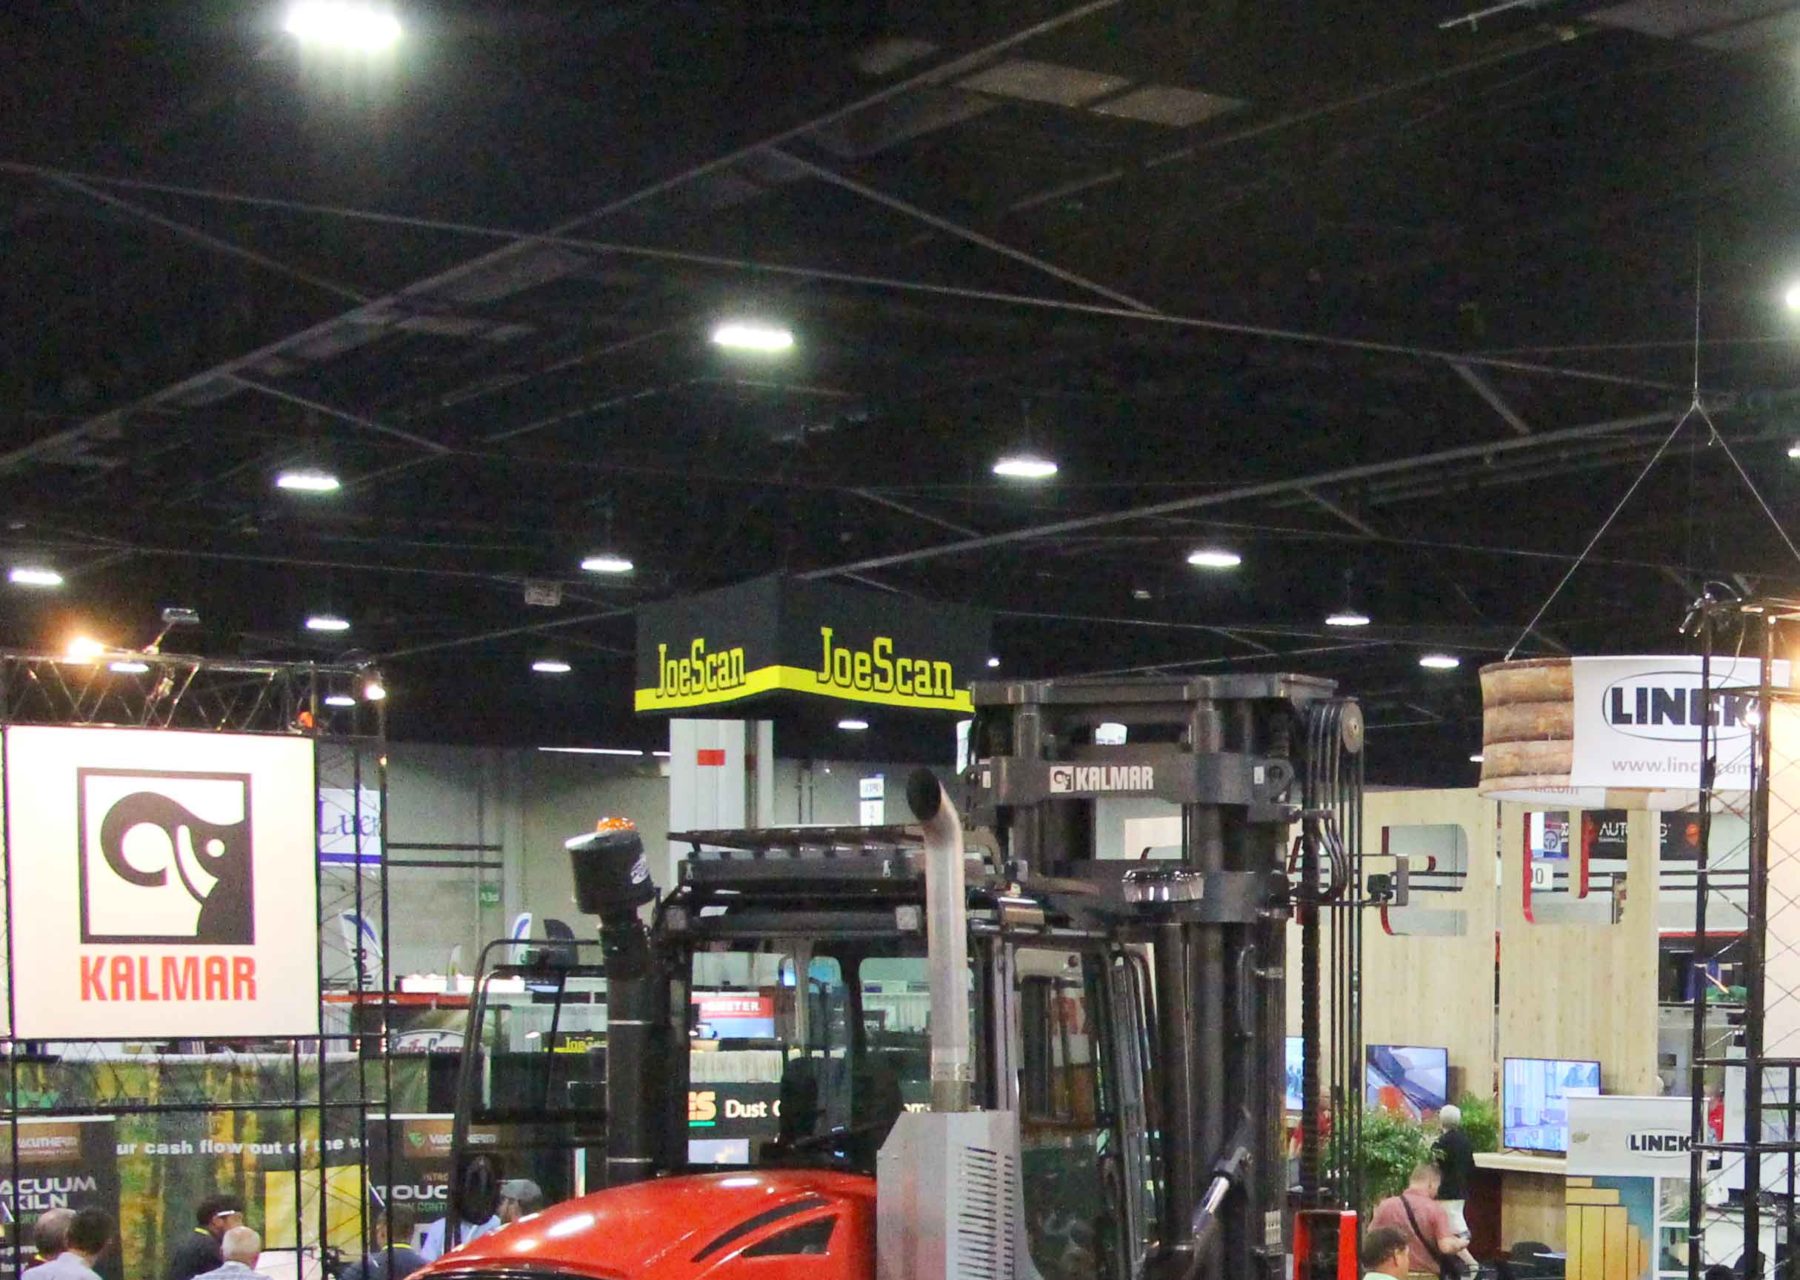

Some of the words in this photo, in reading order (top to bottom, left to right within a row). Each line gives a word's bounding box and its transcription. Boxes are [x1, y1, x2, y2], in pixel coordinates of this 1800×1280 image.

[655, 637, 746, 697] JoeScan
[816, 626, 955, 698] JoeScan
[1076, 766, 1154, 791] KALMAR
[79, 955, 257, 1001] KALMAR
[725, 1099, 766, 1118] Dust
[144, 1140, 194, 1155] cash
[200, 1139, 243, 1154] flow
[250, 1141, 283, 1155] out
[1630, 1134, 1693, 1152] LINCK
[0, 1176, 97, 1194] ACUUM
[376, 1184, 449, 1200] TOUC
